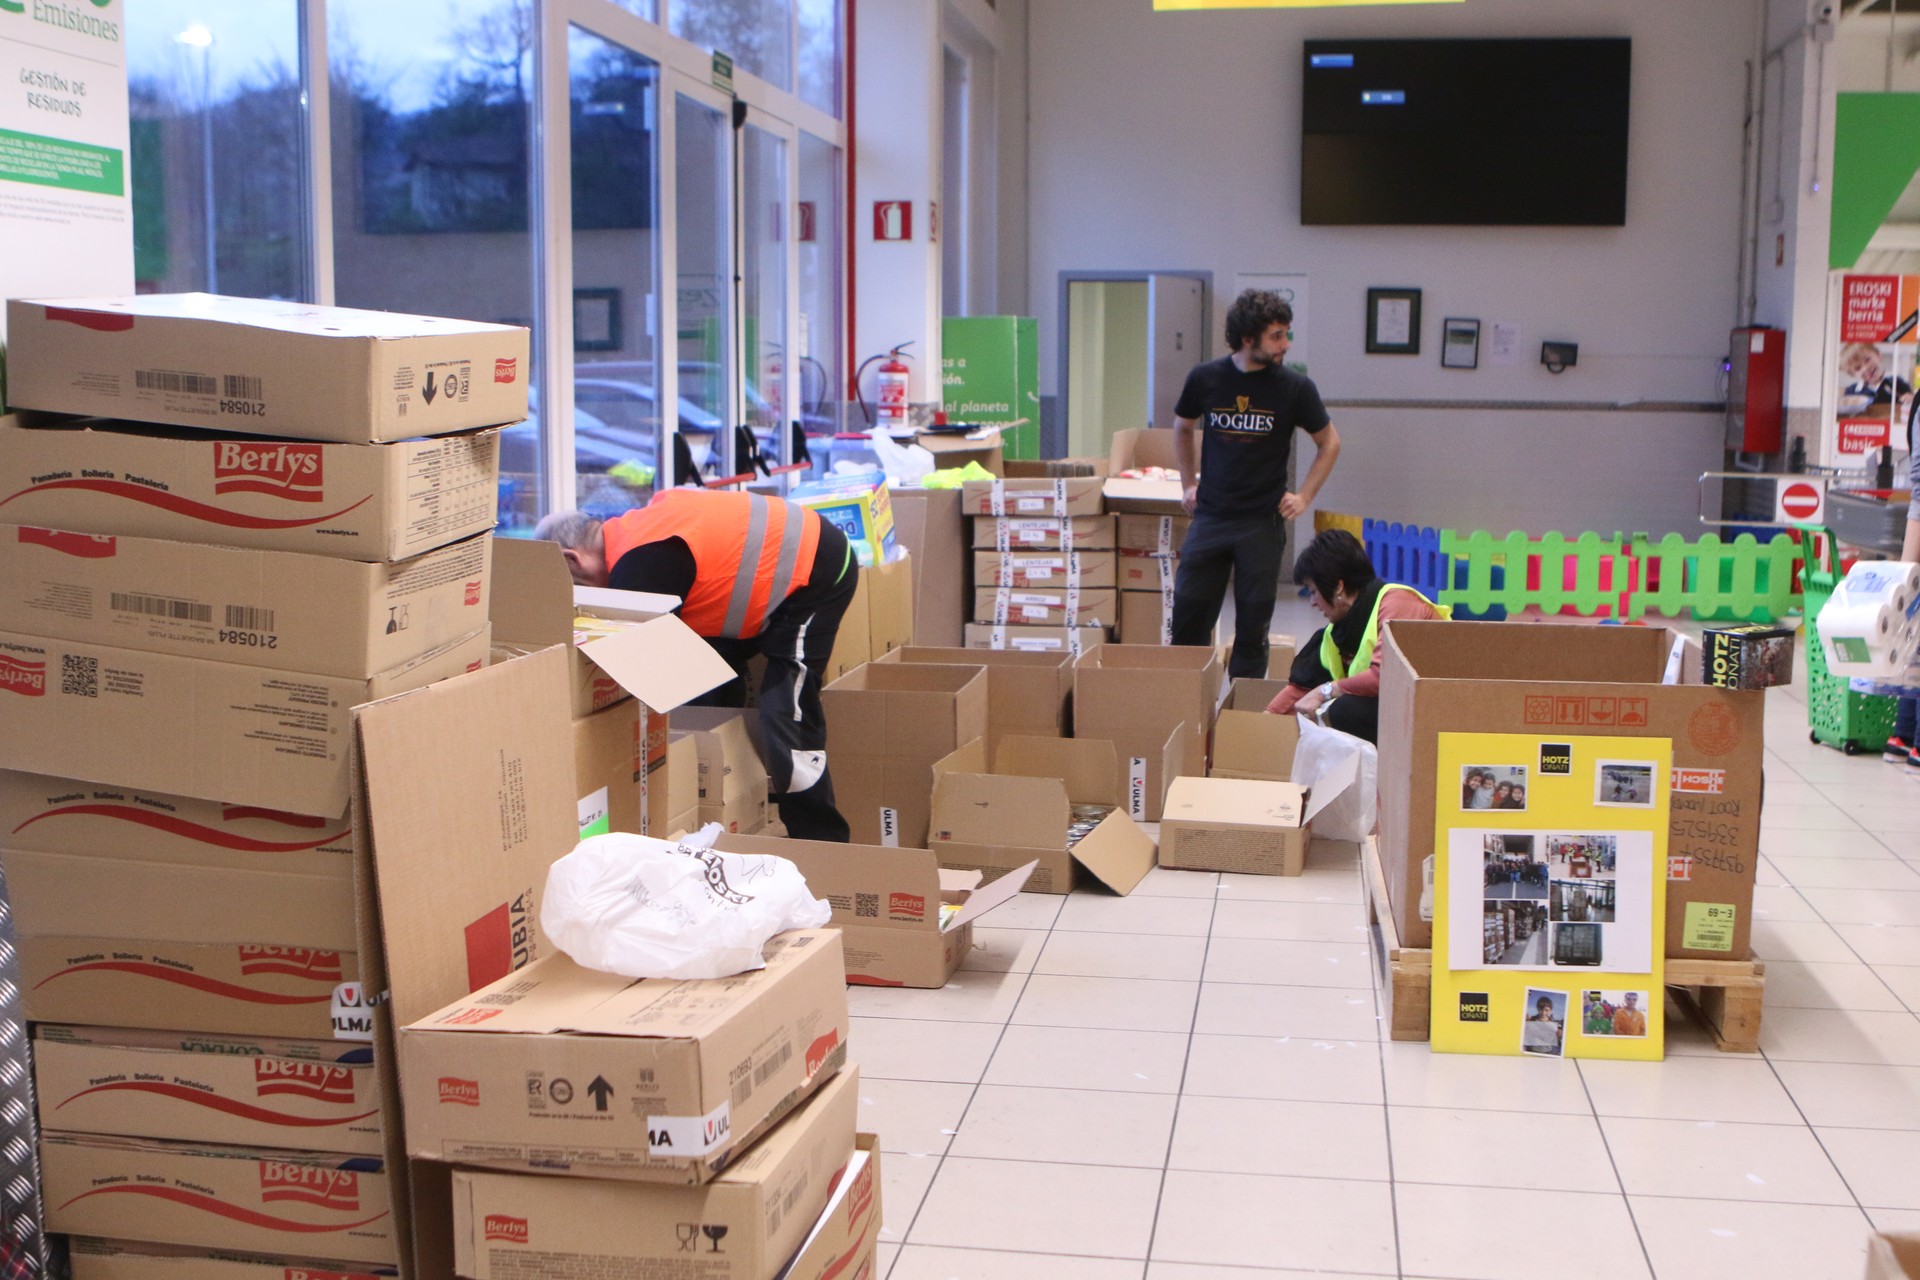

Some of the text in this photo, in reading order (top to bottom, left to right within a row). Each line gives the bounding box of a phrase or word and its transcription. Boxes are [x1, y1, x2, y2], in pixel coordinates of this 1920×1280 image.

[33, 1, 119, 43] Emisiones
[20, 67, 87, 97] GESTIÓN DE
[27, 92, 82, 118] RESIDUOS
[1849, 281, 1893, 297] EROSKI
[1848, 296, 1887, 310] marka
[1847, 309, 1884, 323] berria
[219, 400, 266, 417] 210584
[960, 400, 1009, 416] planeta
[1210, 412, 1275, 431] POGUES
[1843, 436, 1876, 452] basic
[218, 443, 318, 482] Berlys
[218, 629, 278, 649] 210584
[1712, 633, 1730, 688] HOTZ
[1542, 755, 1570, 765] HOTZ
[1132, 788, 1141, 814] ULMA
[884, 809, 893, 836] ULMA
[890, 897, 924, 912] Berlys
[1461, 1003, 1489, 1013] HOTZ
[440, 1081, 478, 1100] Berlys
[263, 1161, 352, 1191] Berlys
[487, 1219, 527, 1237] Berlys
